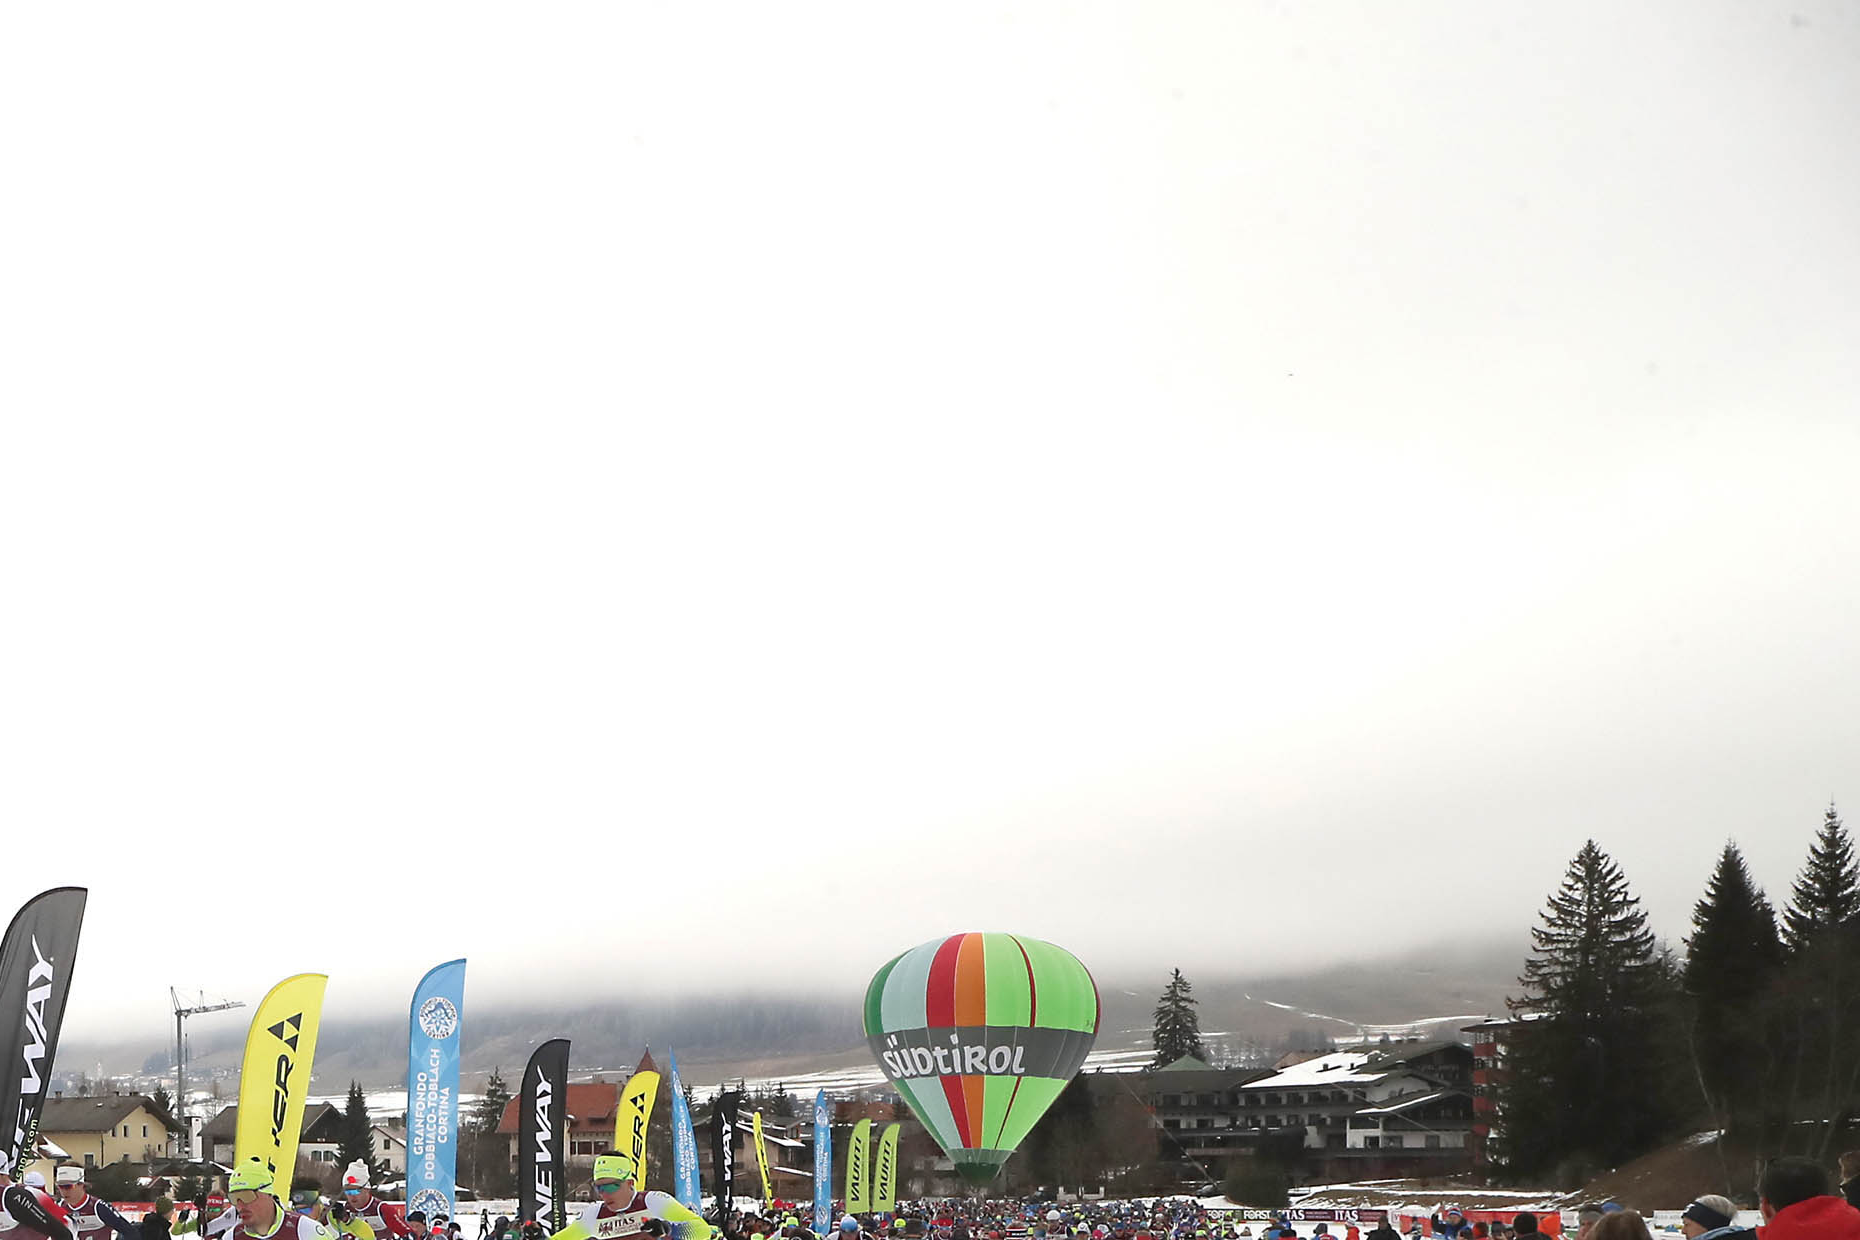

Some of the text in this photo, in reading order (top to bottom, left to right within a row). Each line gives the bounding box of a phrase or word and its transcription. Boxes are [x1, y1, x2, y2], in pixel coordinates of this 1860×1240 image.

[20, 933, 54, 1094] WAY
[412, 1072, 428, 1156] GRANFONDO
[424, 1048, 440, 1180] DOBBIACO-TOBLACH
[438, 1086, 451, 1144] CORTINA
[535, 1064, 553, 1163] WAY
[851, 1137, 862, 1202] VAUHTI
[879, 1140, 891, 1201] VAUHTI
[614, 1216, 636, 1227] ITAS
[1243, 1210, 1270, 1220] FORST
[1335, 1209, 1359, 1221] ITAS
